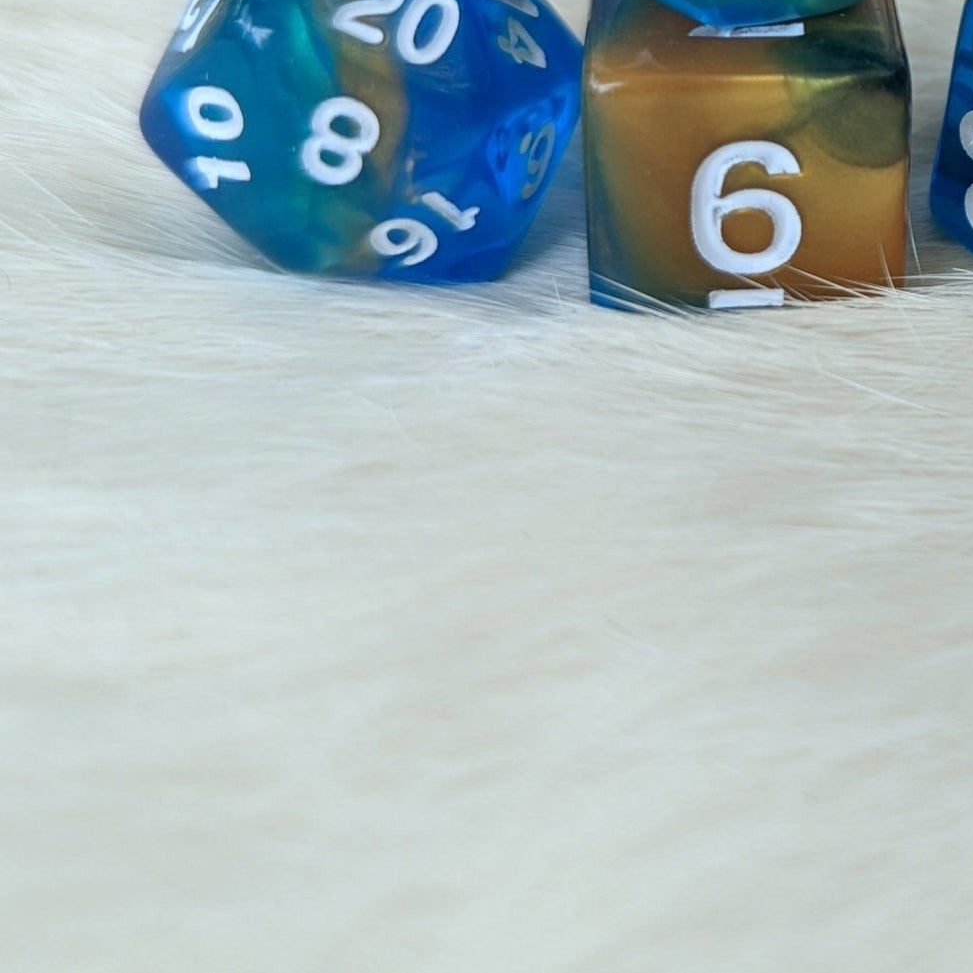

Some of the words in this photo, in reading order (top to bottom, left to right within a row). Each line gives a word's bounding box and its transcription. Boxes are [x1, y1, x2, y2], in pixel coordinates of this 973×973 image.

[189, 85, 251, 189] 10
[301, 96, 380, 186] 8
[691, 140, 803, 275] 6
